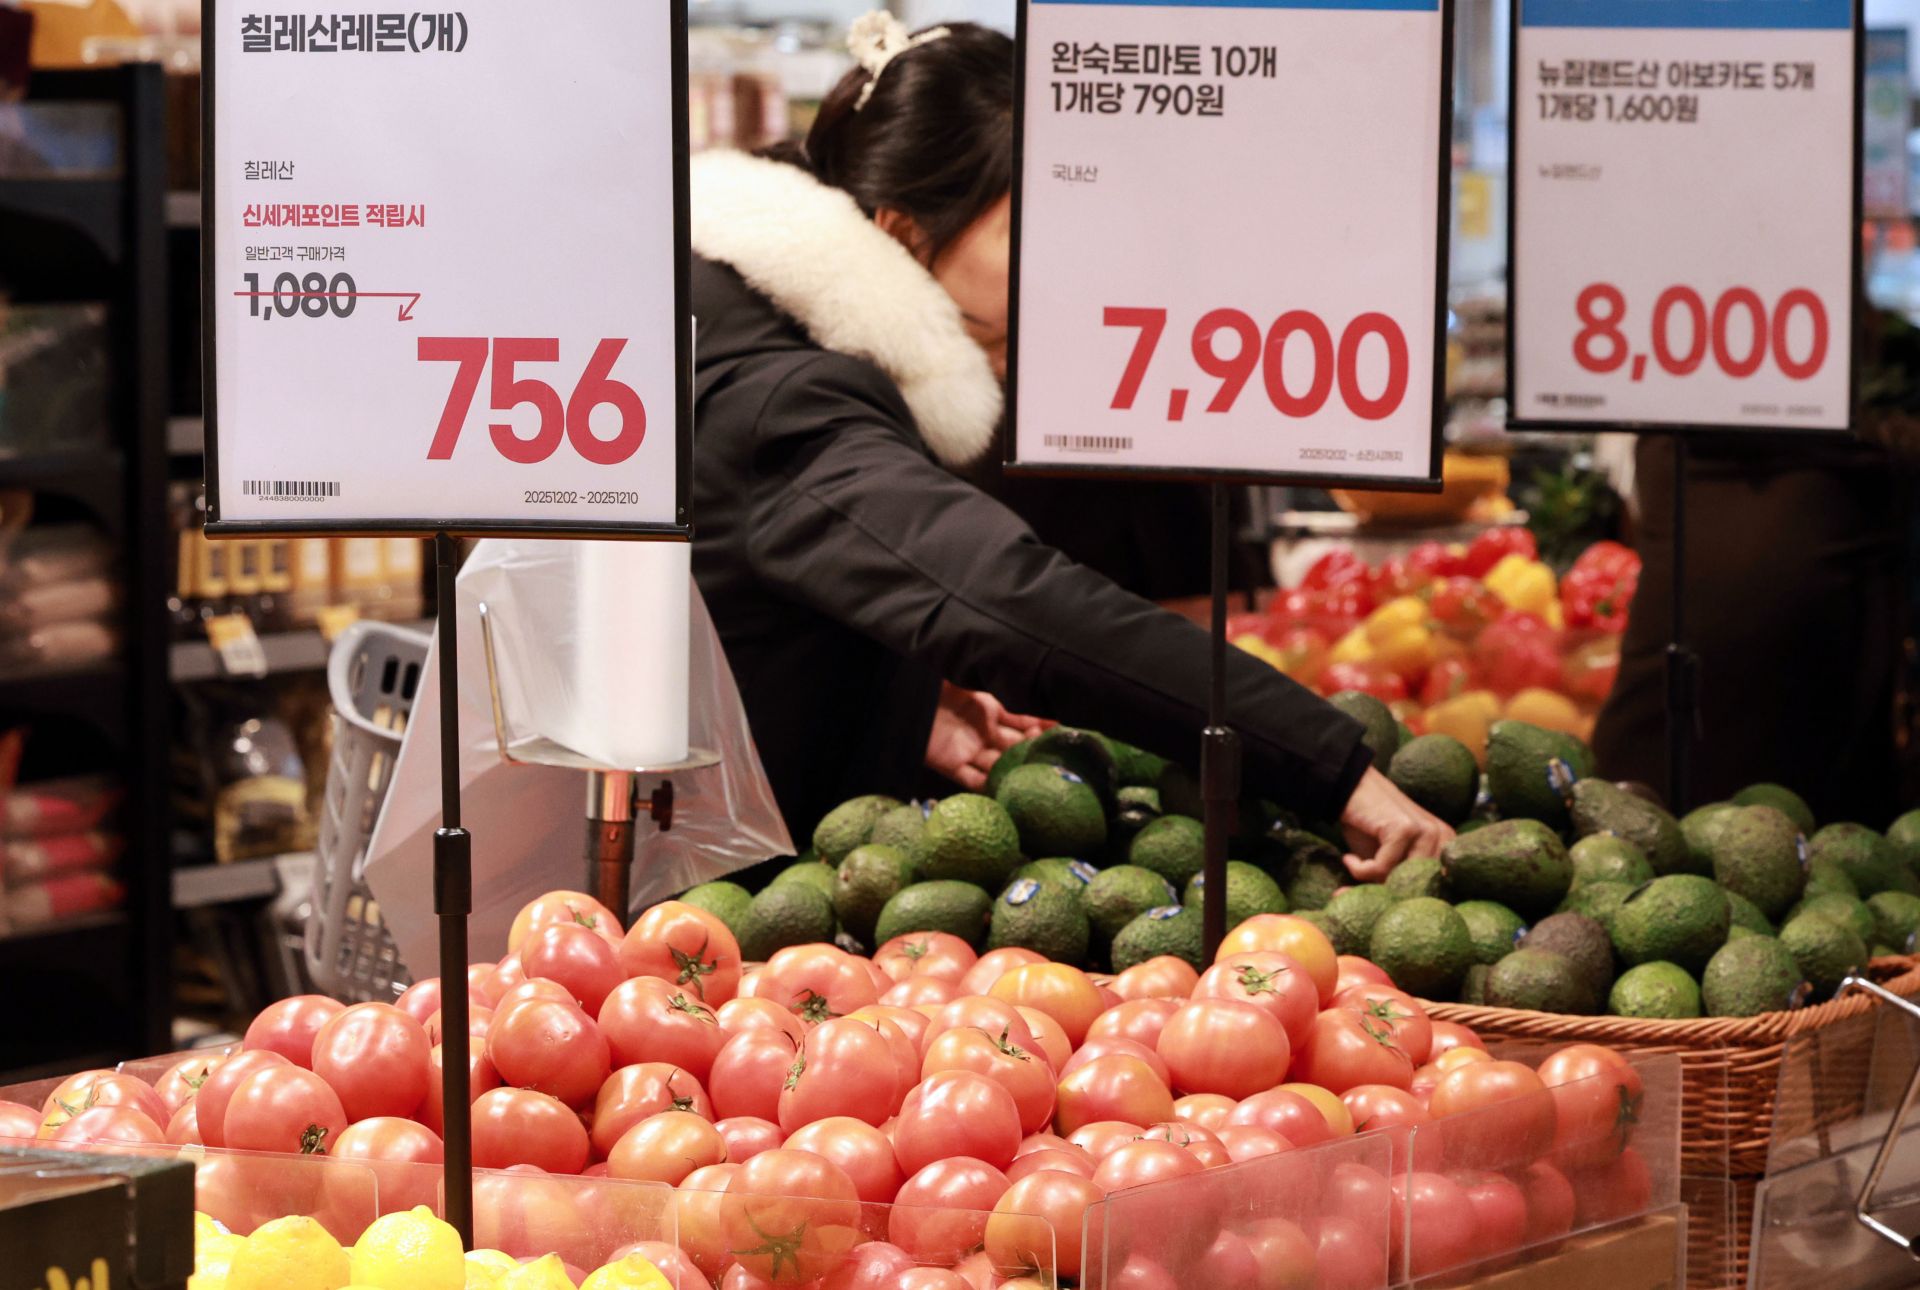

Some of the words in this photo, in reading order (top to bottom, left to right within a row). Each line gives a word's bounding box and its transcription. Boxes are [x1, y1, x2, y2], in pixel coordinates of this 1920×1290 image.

[241, 11, 469, 54] 칠레산레몬(개)
[1051, 41, 1202, 76] 완숙토마토
[1210, 45, 1277, 79] 10개
[1538, 59, 1660, 90] 뉴질랜드산
[1667, 61, 1765, 90] 아보카도
[1772, 62, 1815, 91] 5개
[1050, 81, 1126, 115] 1개당
[1132, 83, 1224, 117] 790원
[1537, 93, 1598, 122] 1개당
[1604, 94, 1699, 123] 1,600원
[244, 160, 295, 181] 칠레산
[1052, 163, 1099, 183] 국내산
[242, 203, 360, 228] 신세계포인트
[365, 203, 426, 228] 적립시
[245, 246, 294, 262] 일반고객
[296, 246, 345, 262] 구매가격
[243, 271, 357, 321] 1,080
[1571, 282, 1830, 382] 8,000
[1102, 306, 1410, 422] 7,900
[417, 336, 647, 466] 756
